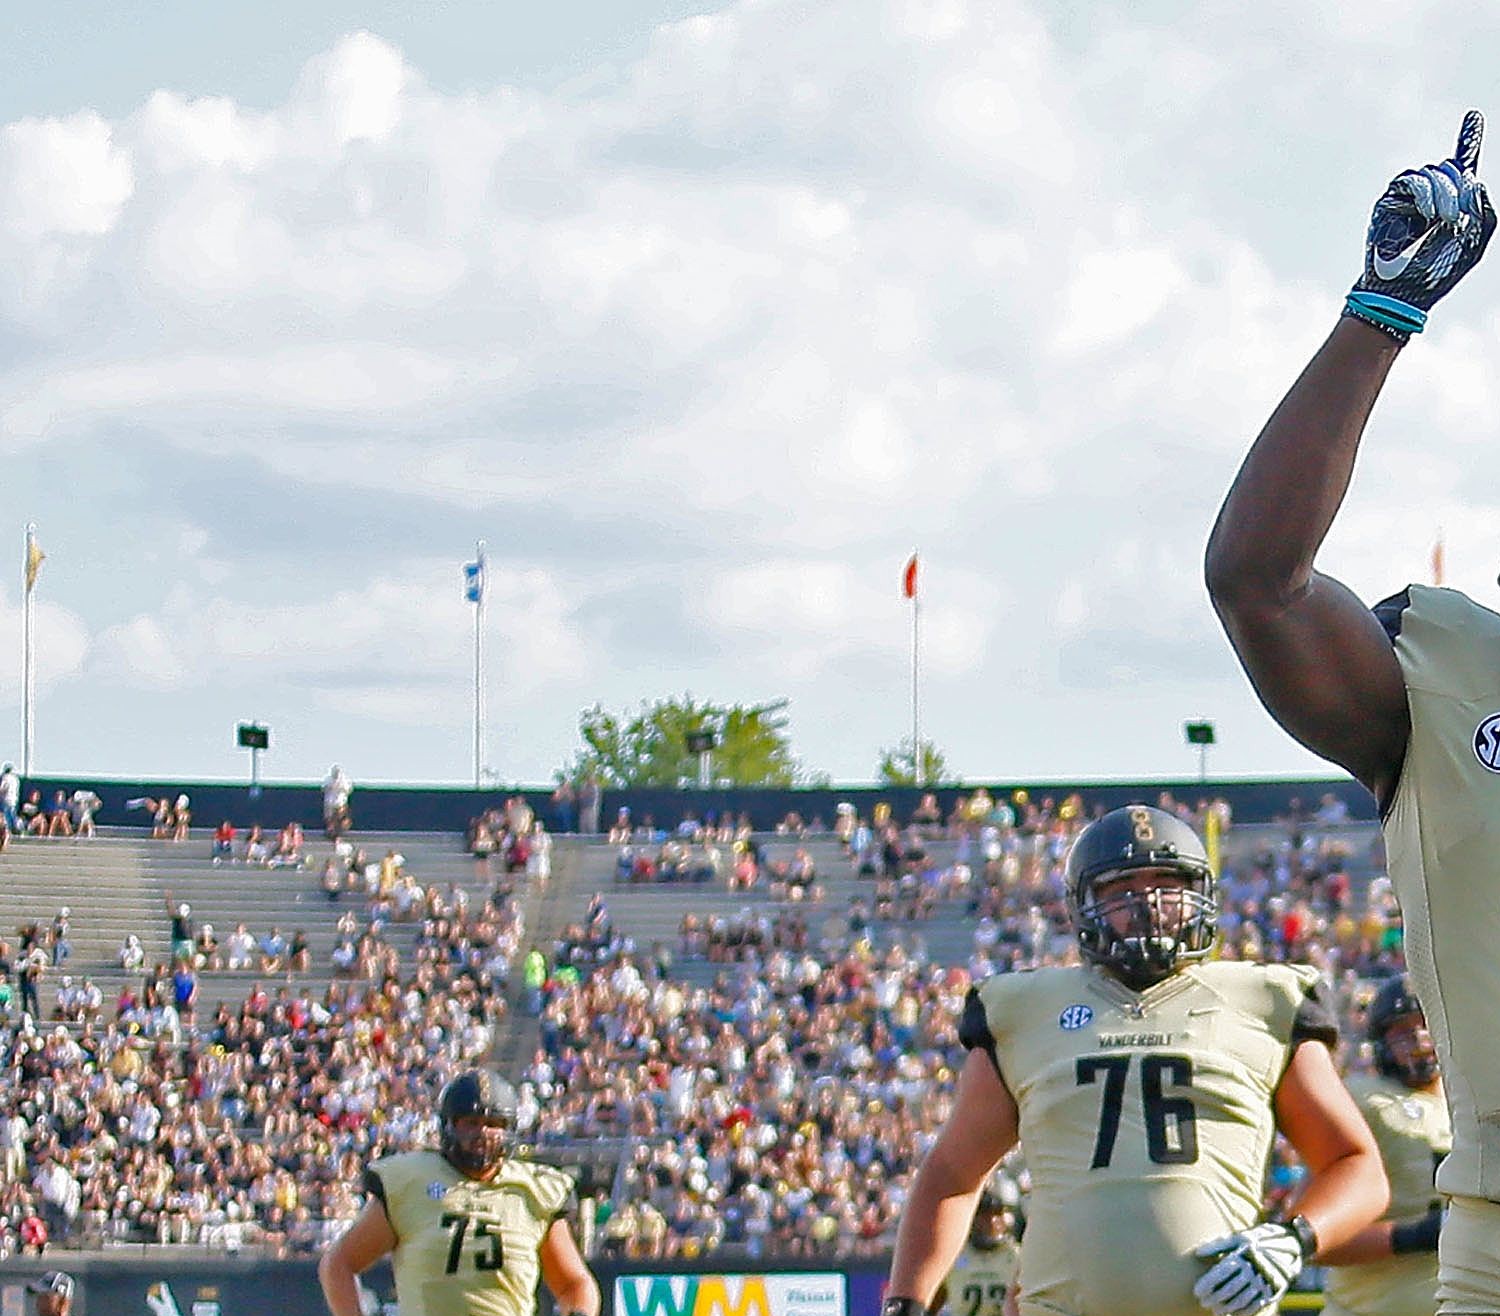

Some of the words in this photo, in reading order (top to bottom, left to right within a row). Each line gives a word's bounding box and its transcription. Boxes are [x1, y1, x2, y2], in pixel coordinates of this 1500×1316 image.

[1061, 1006, 1092, 1029] SEC
[1099, 1031, 1172, 1048] VANDERBILT
[1076, 1052, 1199, 1170] 76
[441, 1212, 504, 1275] 75
